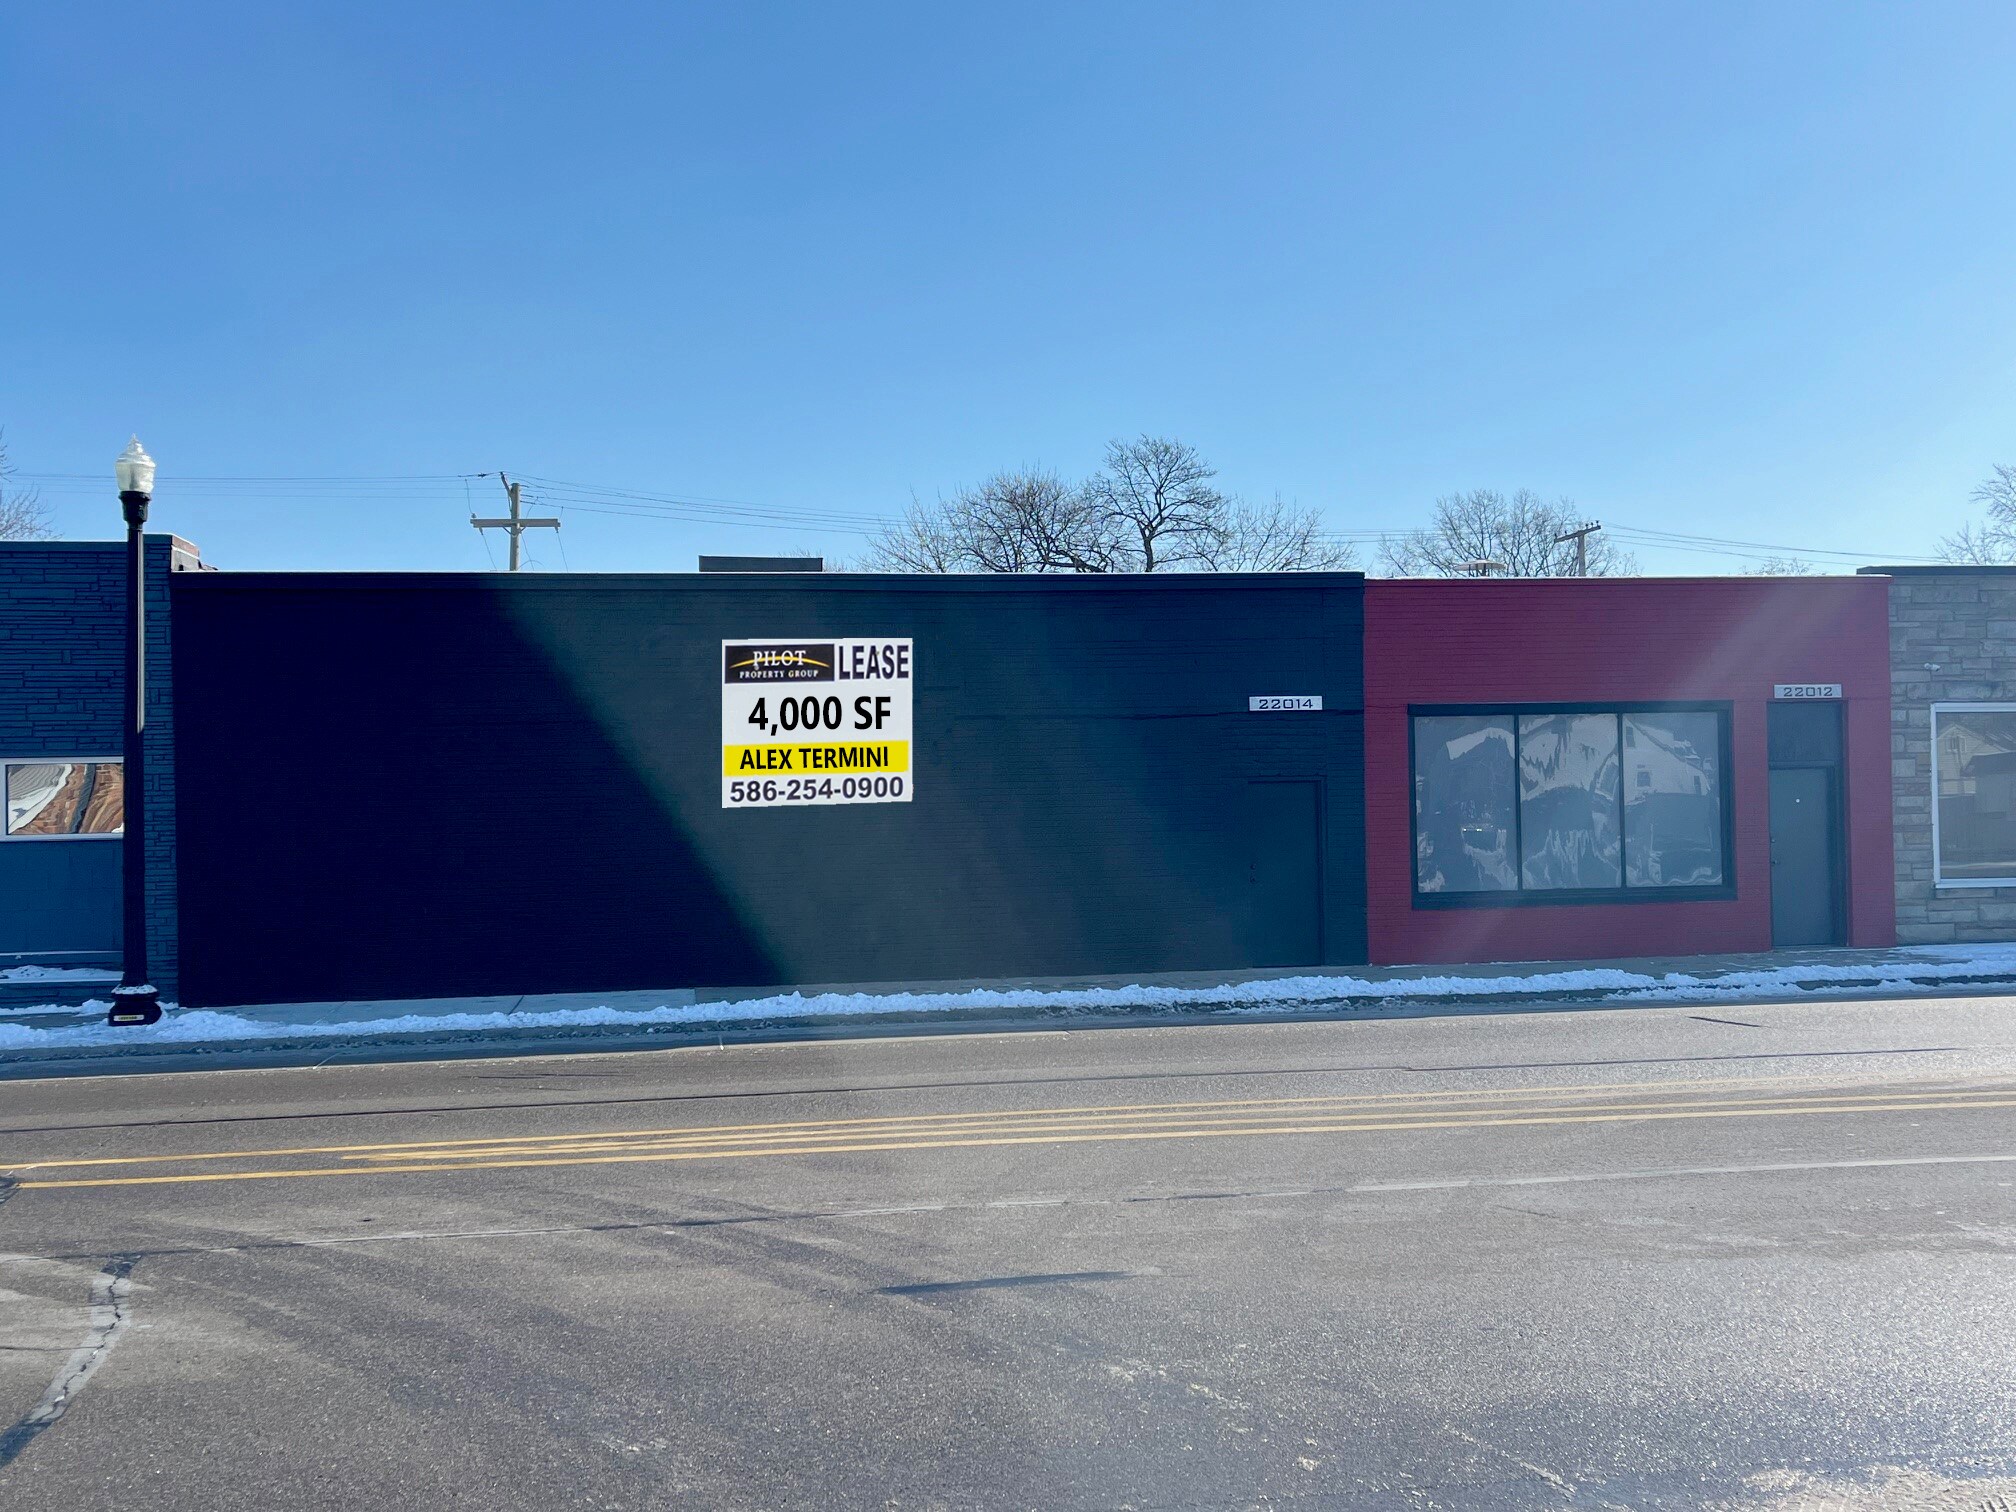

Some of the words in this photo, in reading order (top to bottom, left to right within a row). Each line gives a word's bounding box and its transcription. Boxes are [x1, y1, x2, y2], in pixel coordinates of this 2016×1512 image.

[753, 650, 806, 667] PILOT
[839, 644, 909, 680] LEASE
[739, 669, 785, 679] PROPERTY
[788, 669, 818, 678] GROUP
[1783, 687, 1833, 697] 22012
[1259, 698, 1313, 709] 22014
[748, 696, 842, 736] 4,000
[854, 696, 891, 730] SF
[739, 749, 792, 770] ALEX
[798, 746, 888, 768] TERMINI
[730, 776, 903, 802] 586-254-0900
